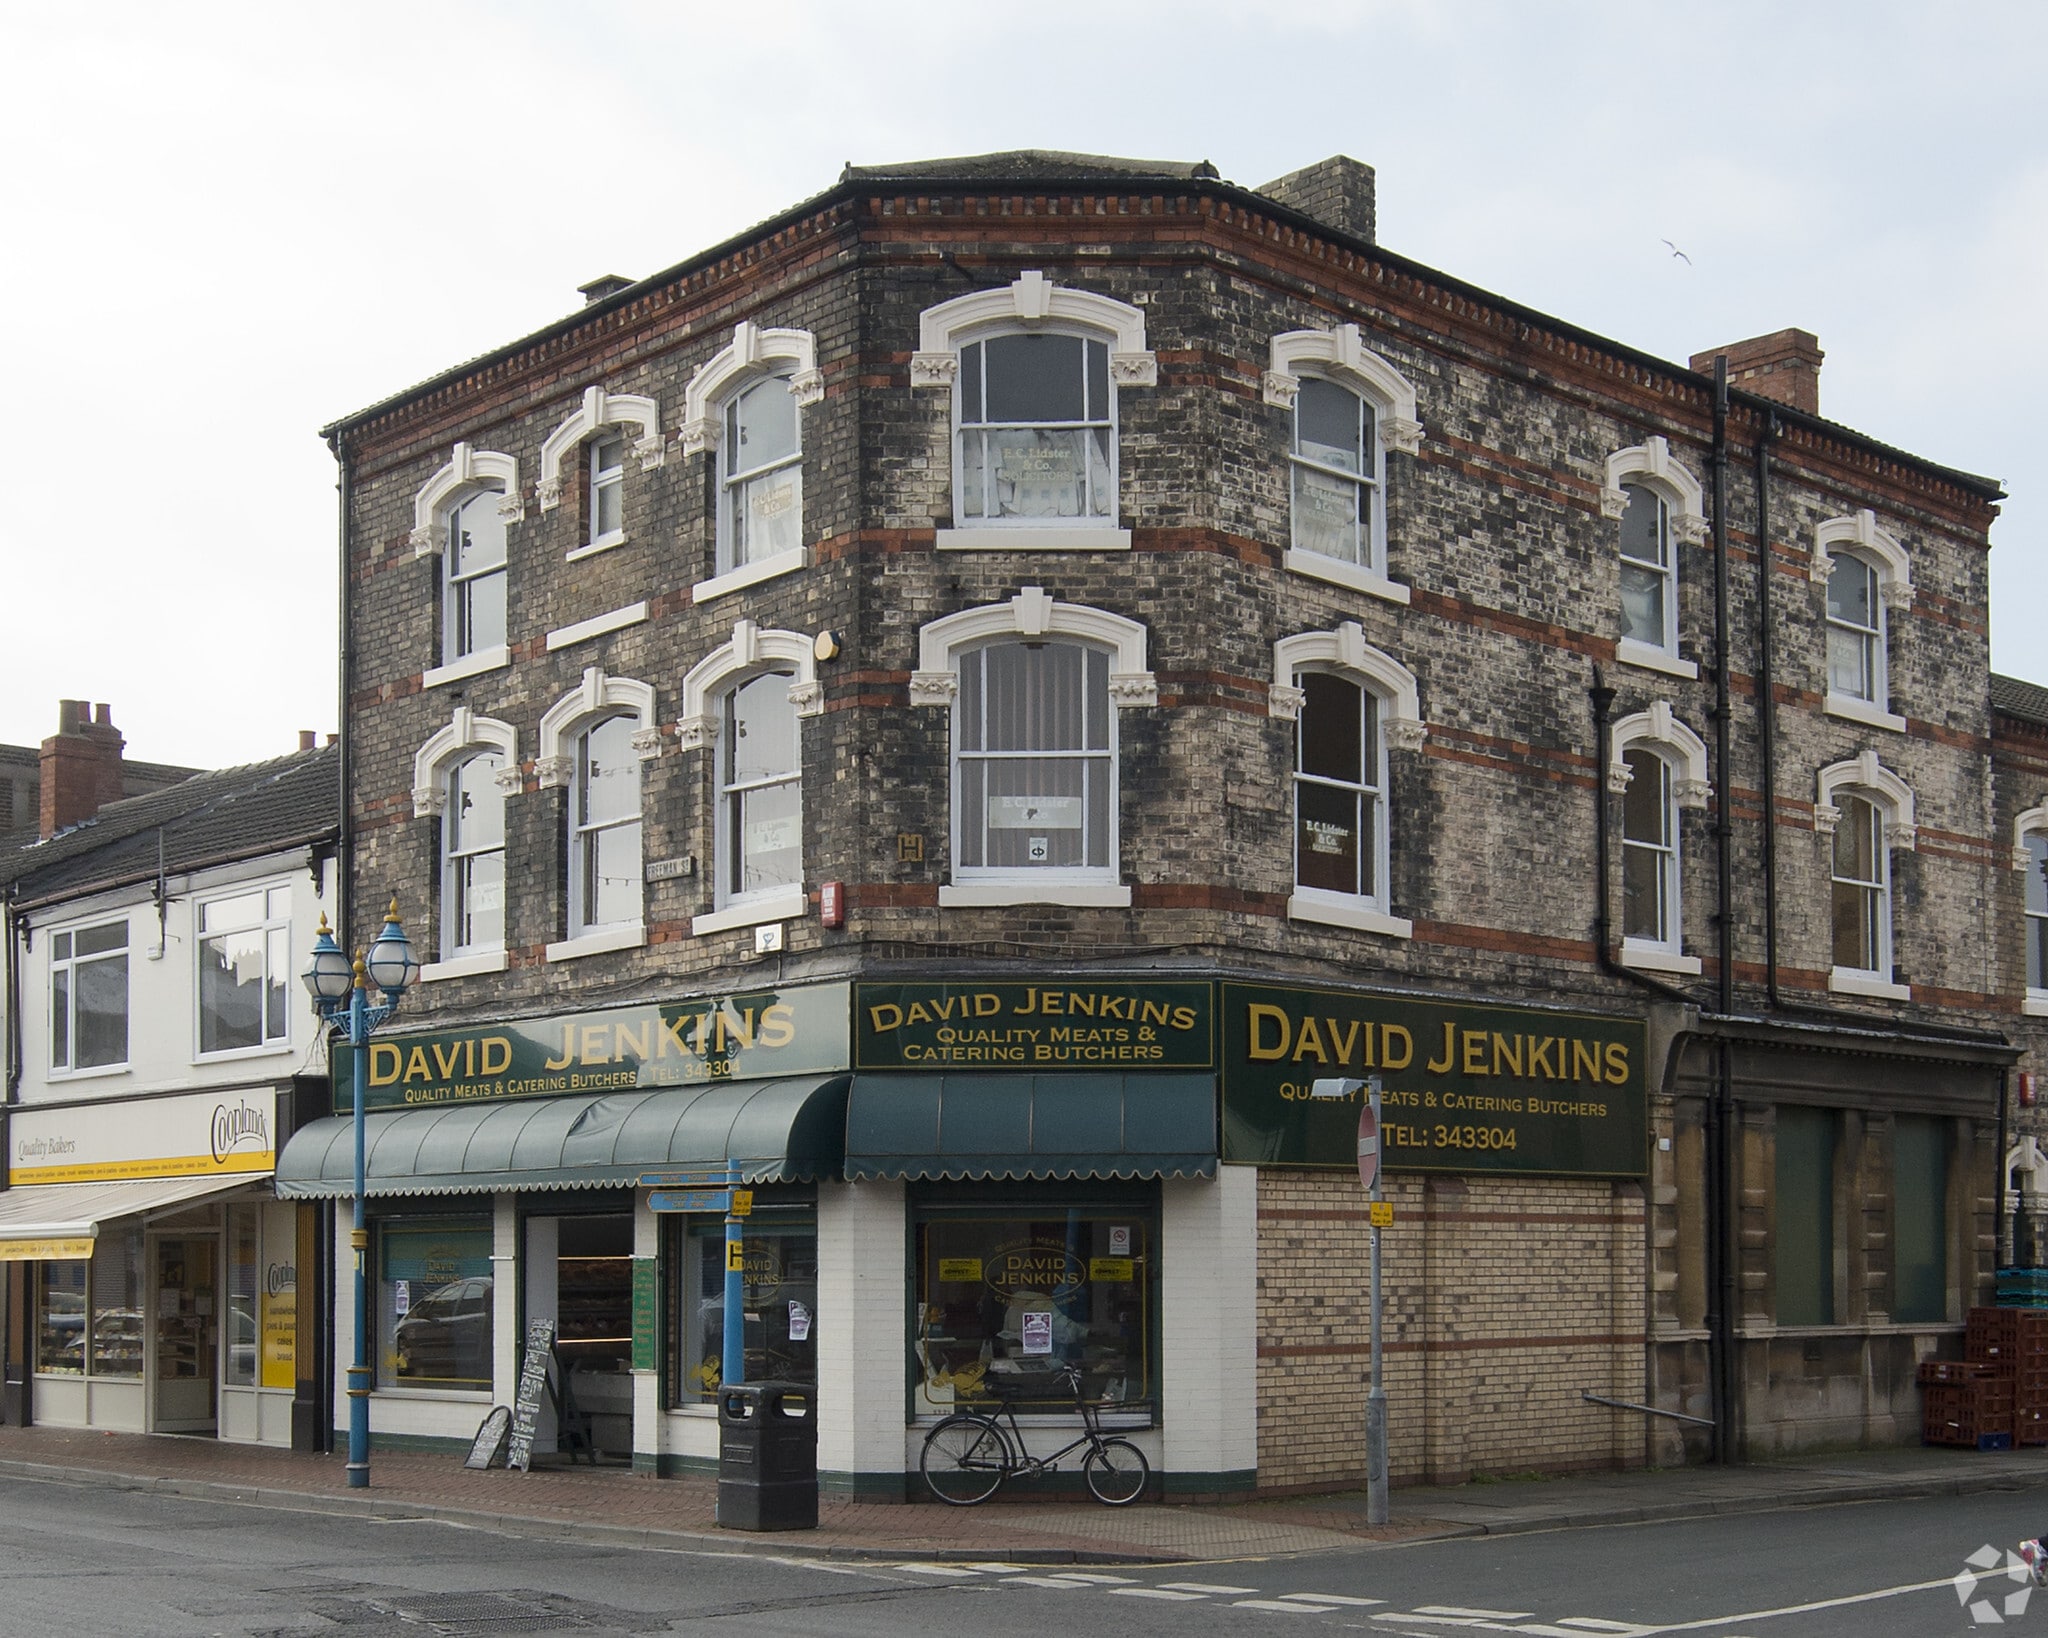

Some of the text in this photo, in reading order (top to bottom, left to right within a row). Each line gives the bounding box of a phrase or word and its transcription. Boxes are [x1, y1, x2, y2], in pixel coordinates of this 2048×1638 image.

[1024, 460, 1052, 470] & Co.
[647, 861, 678, 880] FREEMAN
[869, 987, 1197, 1032] DAVID JENKINS
[368, 1004, 796, 1087] DAVID JENKINS
[936, 1026, 1155, 1045] QUALITY MEATS &
[1247, 1003, 1630, 1085] DAVID JENKINS
[903, 1045, 1164, 1060] CATERING BUTCHERS
[405, 1085, 451, 1103] QUALITY
[455, 1082, 491, 1099] MEATS
[495, 1080, 503, 1095] &
[508, 1076, 566, 1094] CATERING
[571, 1071, 636, 1088] BUTCHERS
[1424, 1091, 1437, 1107] &
[1443, 1093, 1523, 1113] CATERING
[1527, 1097, 1608, 1118] BUTCHERS
[211, 1099, 269, 1164] Cooplands
[1381, 1123, 1517, 1151] TEL: 343304
[19, 1136, 75, 1161] Quality Bakers
[428, 1262, 455, 1271] DAVID
[1007, 1256, 1066, 1270] DAVID
[743, 1273, 779, 1285] NKINS
[996, 1271, 1079, 1285] JENKINS
